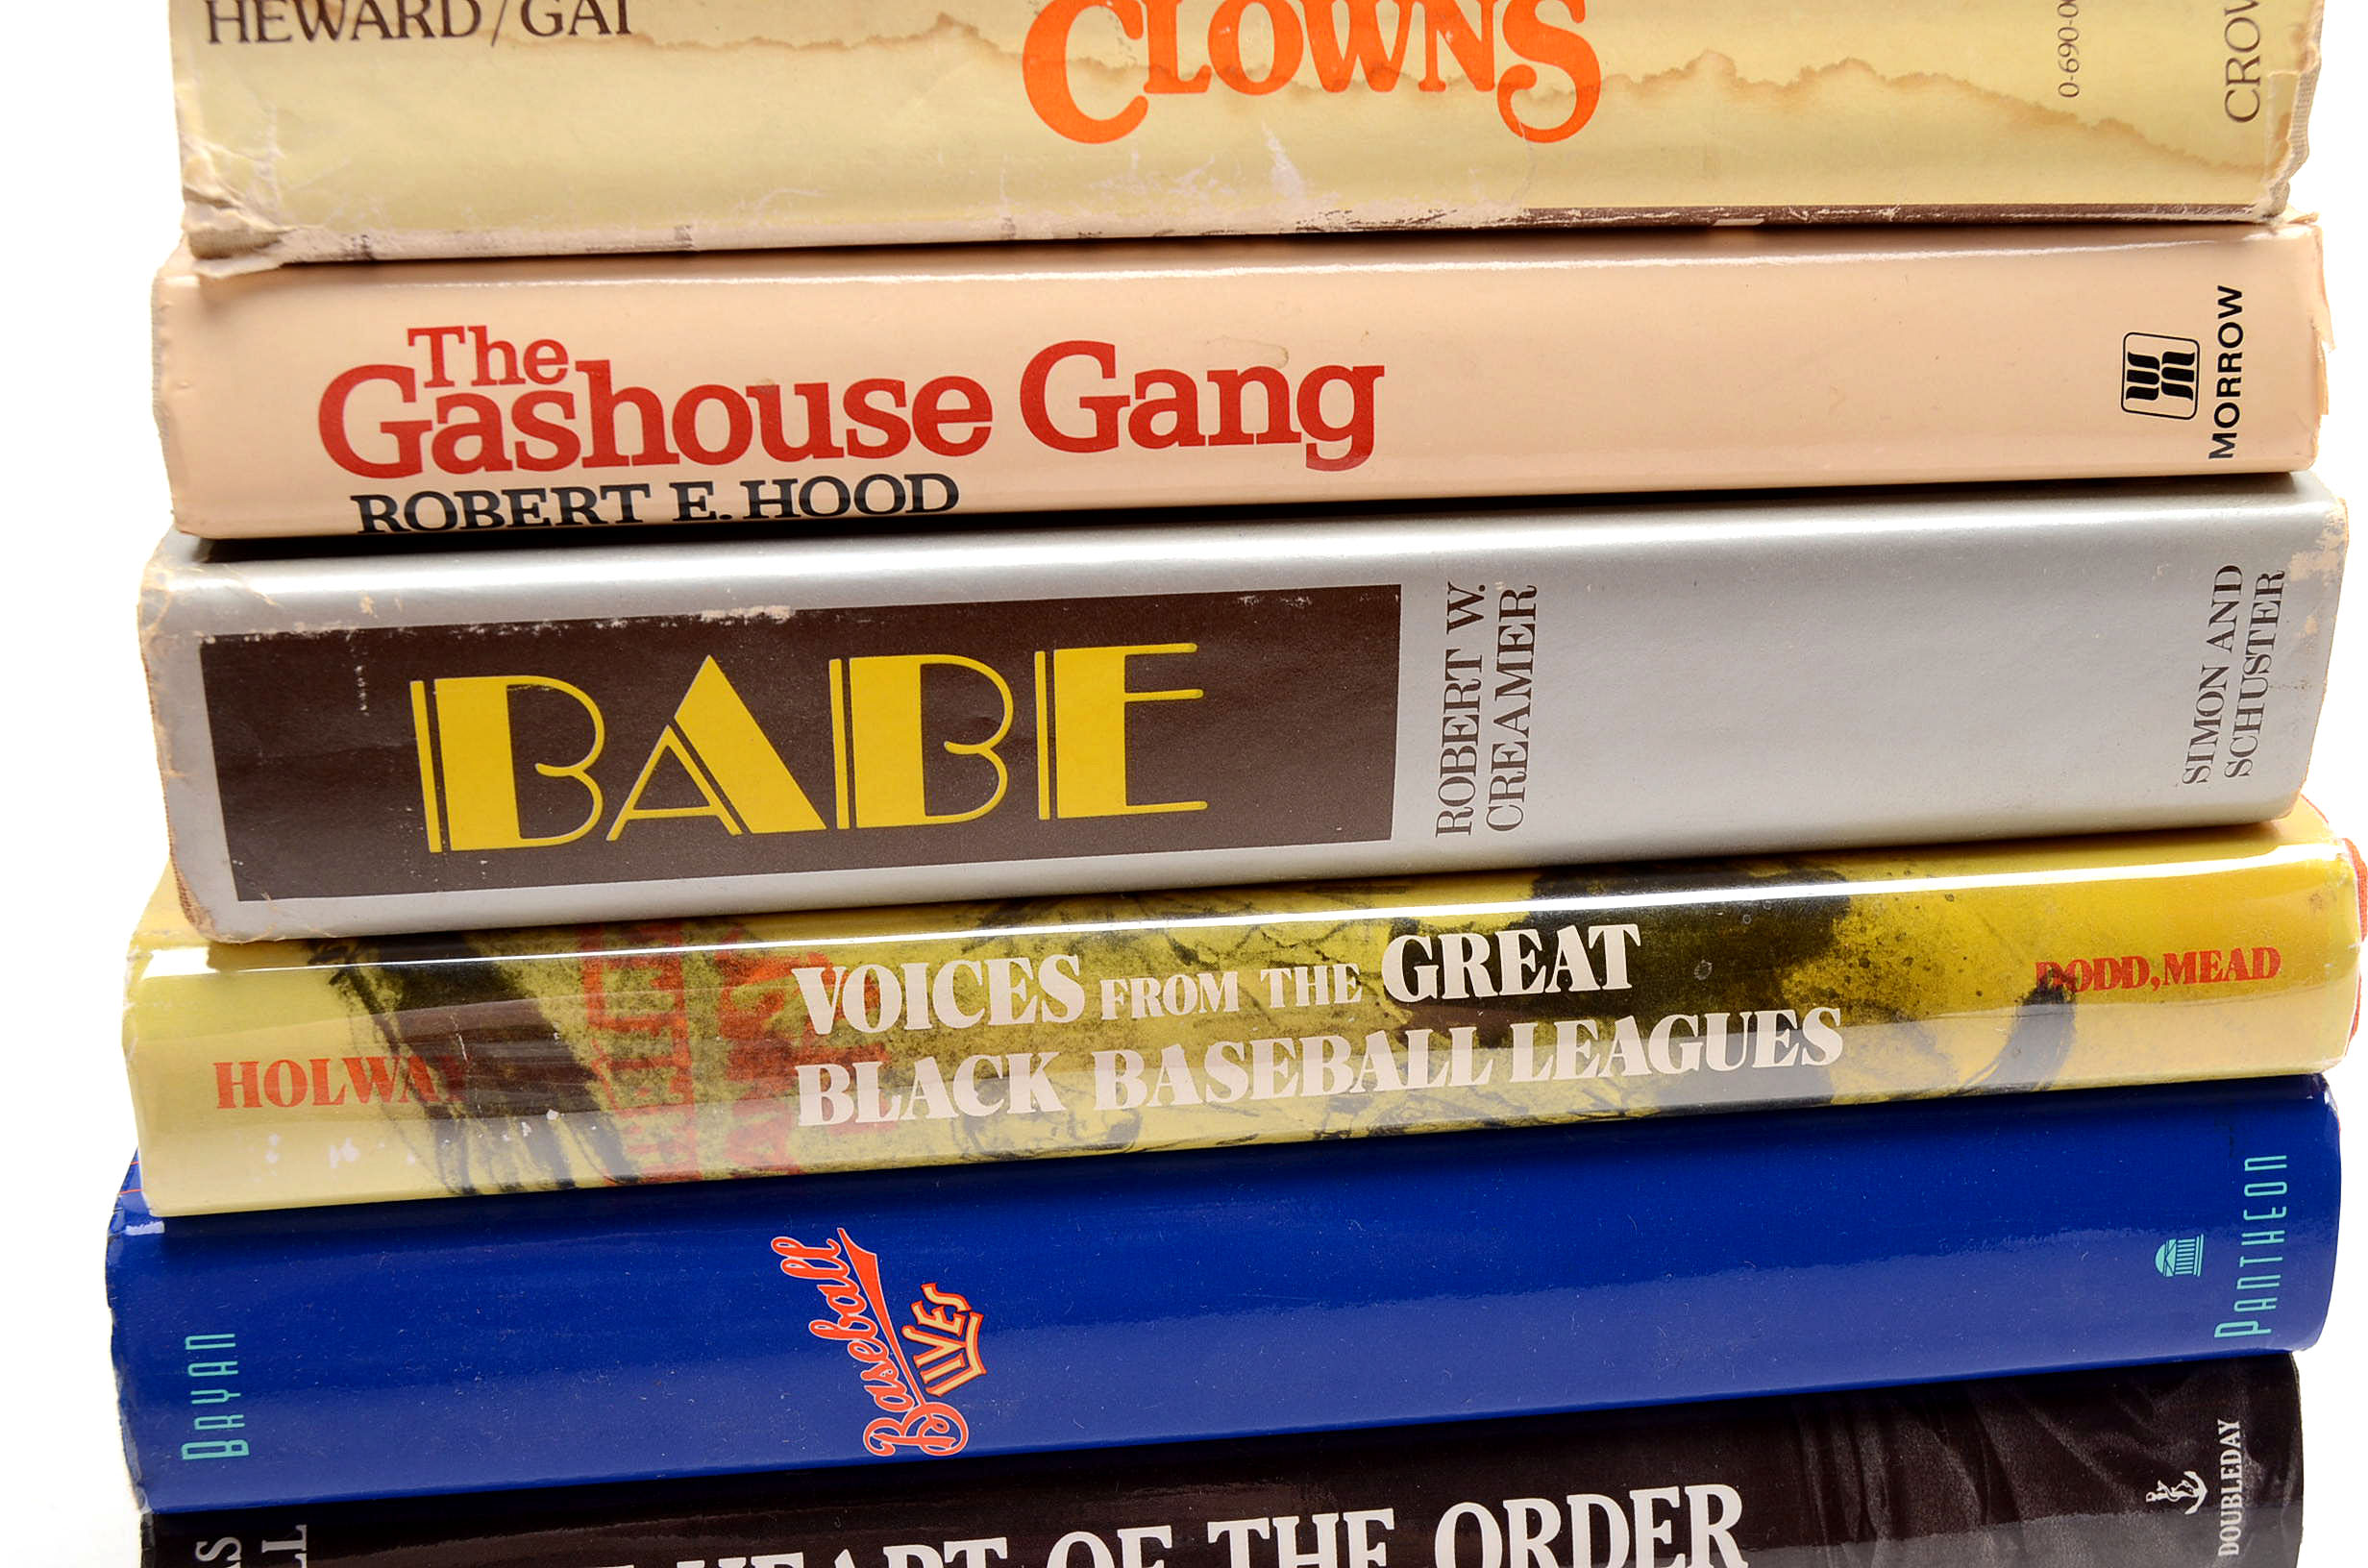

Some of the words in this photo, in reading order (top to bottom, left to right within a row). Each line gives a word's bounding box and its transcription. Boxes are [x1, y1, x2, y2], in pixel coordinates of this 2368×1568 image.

[1023, 0, 1601, 143] CLOWNS
[2058, 0, 2080, 98] 0-690-0
[318, 359, 993, 479] Gashouse
[1020, 340, 1385, 472] Gang
[407, 325, 569, 388] The
[2208, 285, 2243, 459] MORROW
[350, 482, 652, 533] ROBERT
[670, 480, 733, 522] E.
[739, 473, 959, 519] HOOD
[1446, 581, 1486, 635] W.
[2182, 664, 2230, 784] SIMON
[2207, 565, 2243, 653] AND
[2224, 571, 2284, 777] SCHUSTER
[410, 643, 1208, 852] BABE
[1436, 649, 1482, 838] ROBERT
[1486, 585, 1538, 832] CREAMER
[791, 954, 1085, 1035] VOICES
[1100, 970, 1240, 1020] FROM
[1261, 963, 1363, 1009] THE
[1381, 923, 1641, 1003] GREAT
[795, 1051, 1067, 1127] BLACK
[1091, 1026, 1493, 1111] BASEBALL
[1509, 1007, 1844, 1084] LEAGUES
[2214, 1155, 2288, 1337] PANTHEON
[181, 1334, 250, 1460] BRYAN
[771, 1236, 969, 1456] Baseball
[1435, 1484, 1749, 1568] ORDER
[2217, 1419, 2243, 1557] DOUBLEDAY
